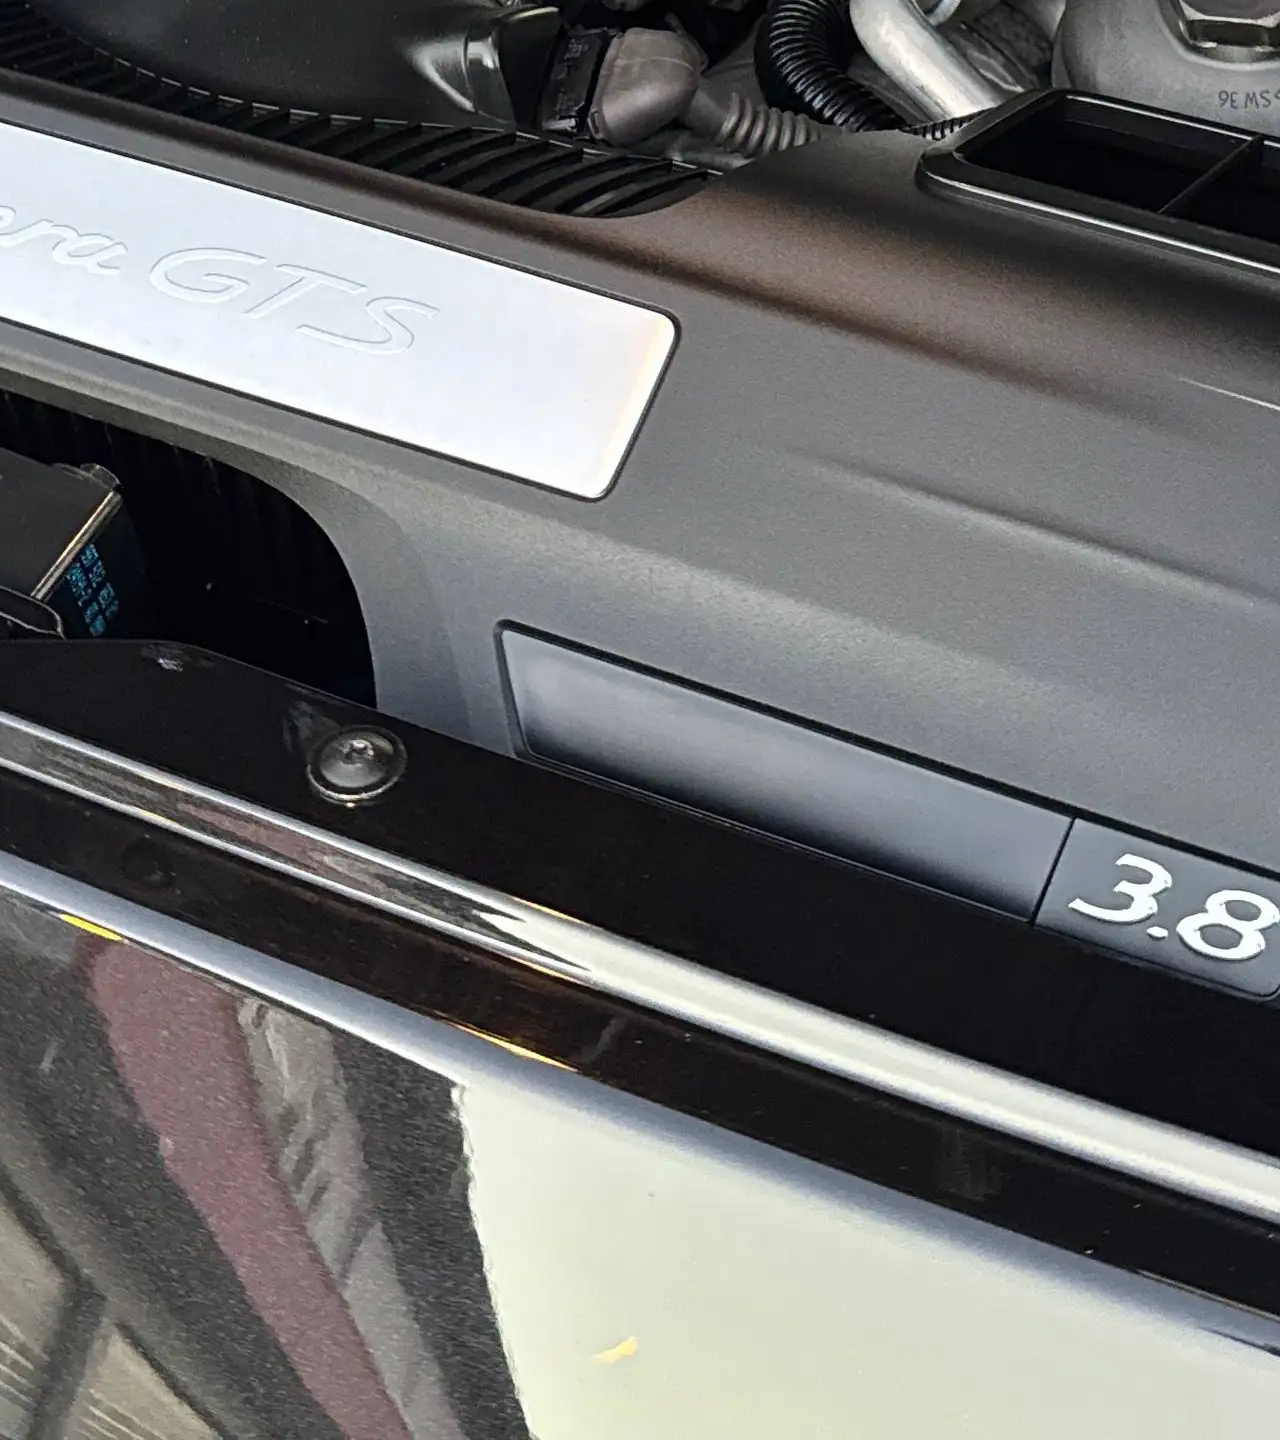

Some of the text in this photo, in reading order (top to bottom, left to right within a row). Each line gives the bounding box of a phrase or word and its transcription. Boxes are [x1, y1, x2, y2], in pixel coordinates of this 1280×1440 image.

[1218, 89, 1240, 110] 36
[1244, 89, 1272, 110] SW
[148, 246, 440, 356] GTS
